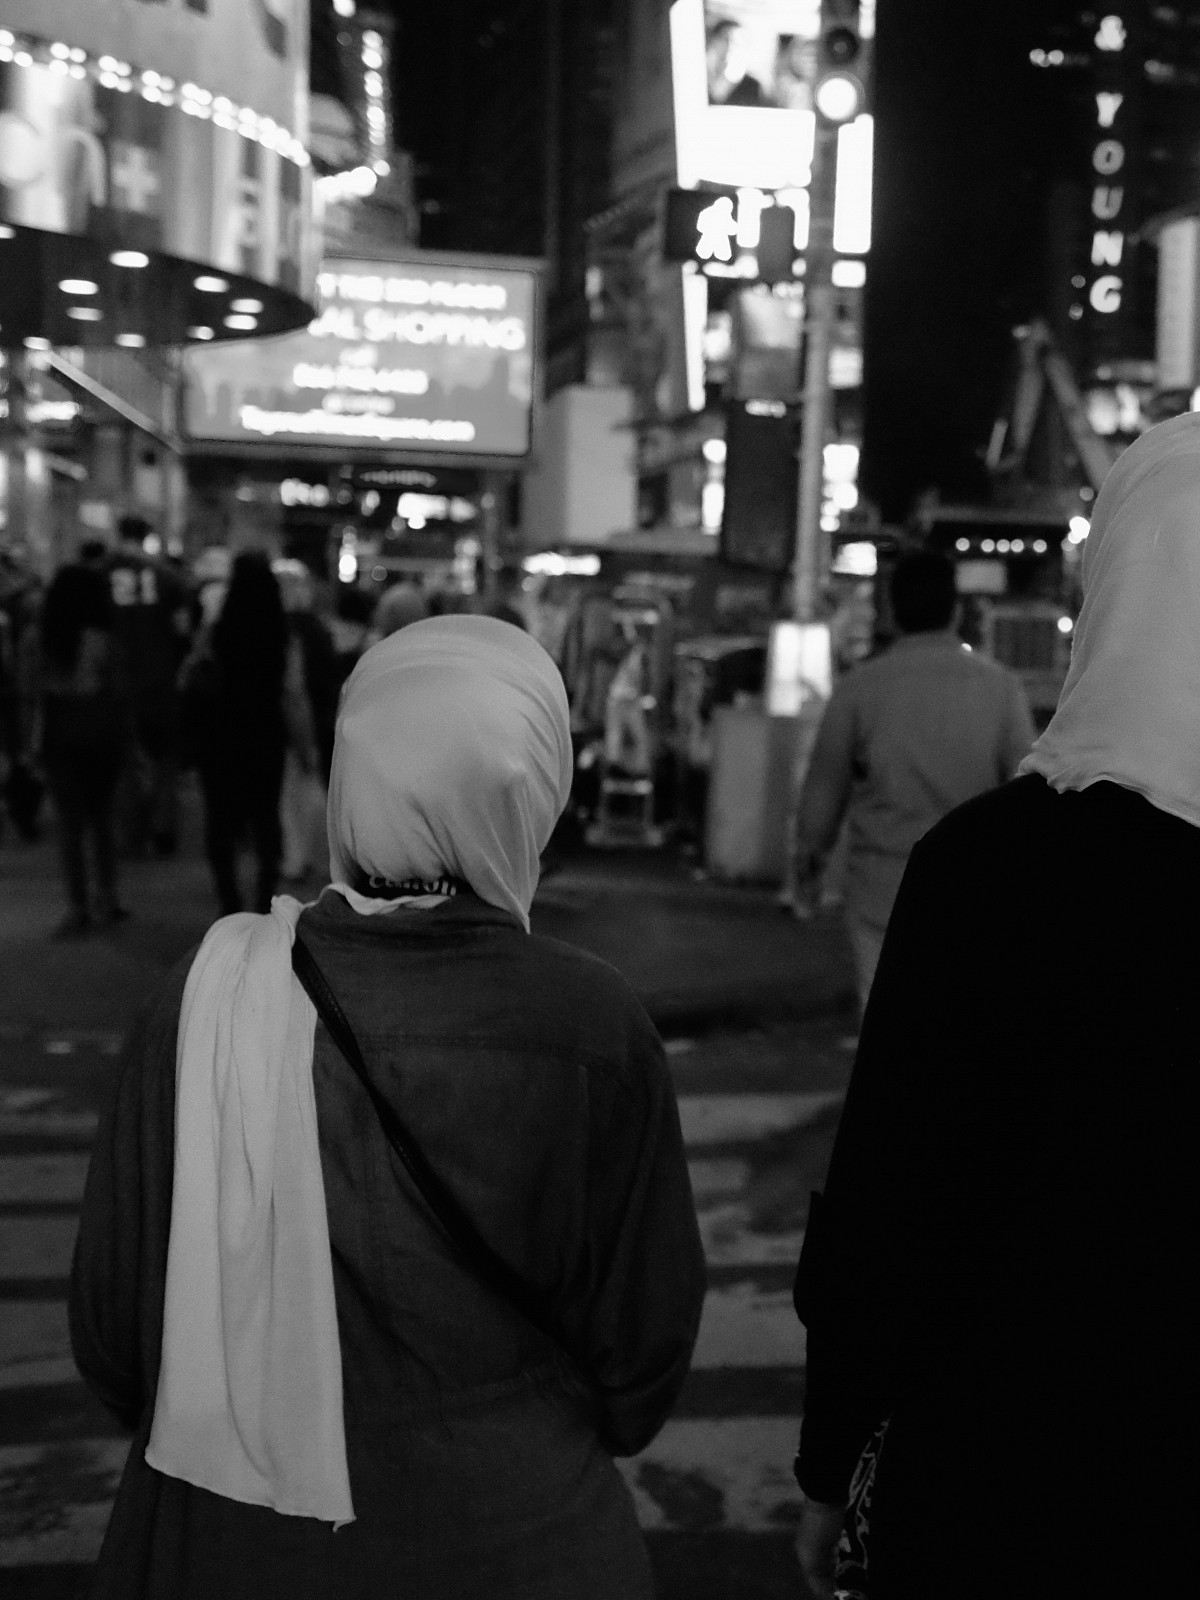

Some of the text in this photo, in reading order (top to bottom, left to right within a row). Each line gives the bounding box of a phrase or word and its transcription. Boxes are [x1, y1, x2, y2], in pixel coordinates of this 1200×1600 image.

[1089, 14, 1127, 313] & YOUNG
[364, 308, 526, 350] SHOPPING
